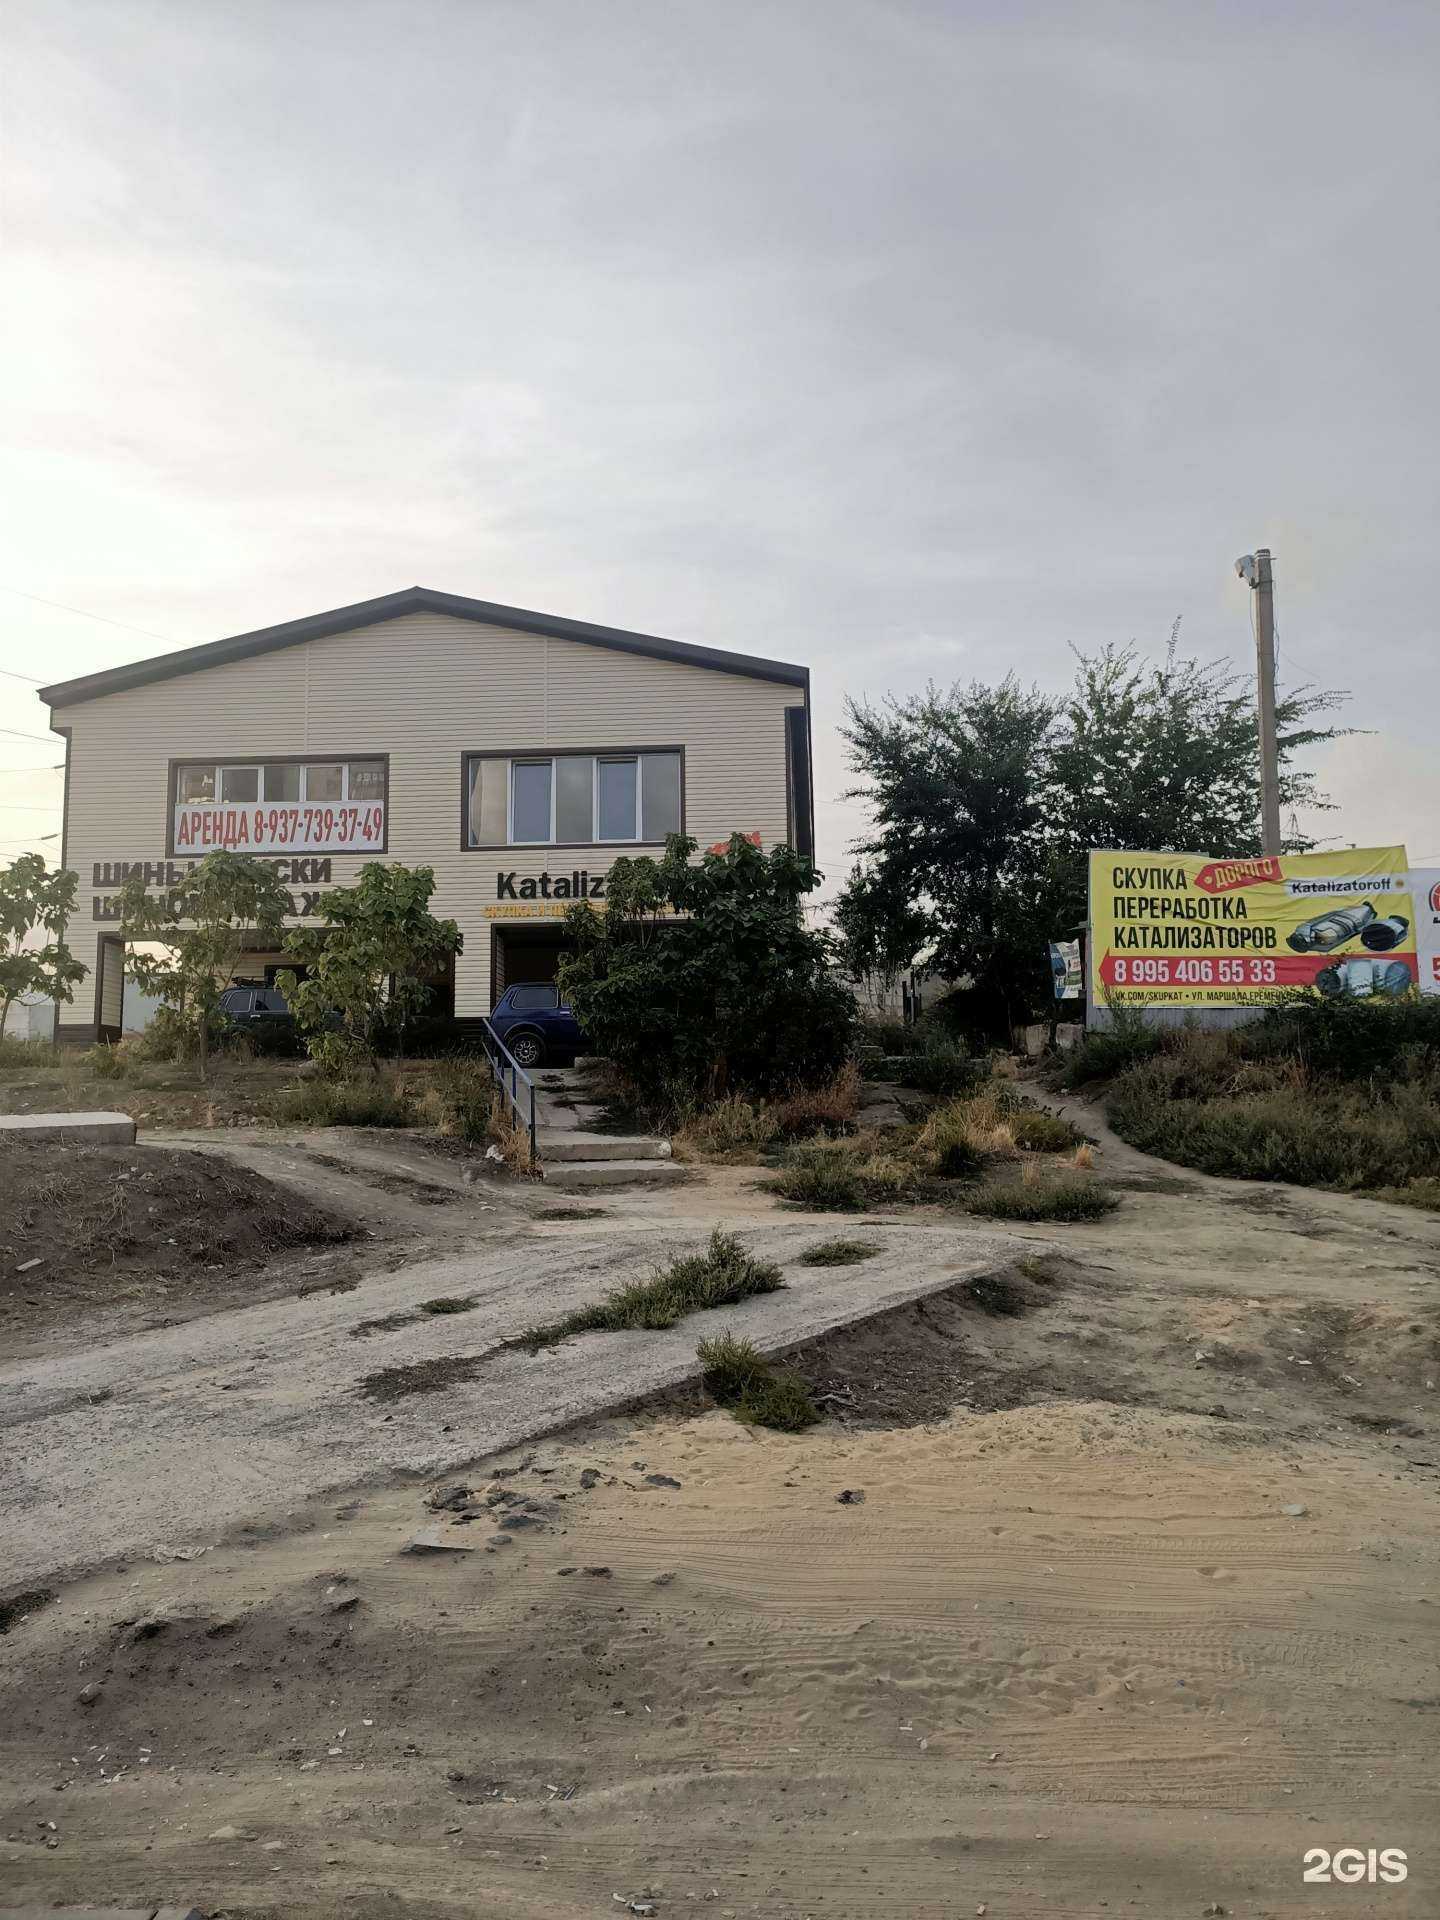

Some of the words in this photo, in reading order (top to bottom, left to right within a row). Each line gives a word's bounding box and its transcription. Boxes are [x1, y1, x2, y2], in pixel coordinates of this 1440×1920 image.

[178, 810, 249, 849] АРЕНДА
[497, 870, 605, 899] Kataliz
[1112, 867, 1188, 890] СКУПКА
[1215, 859, 1273, 888] ДОРОГО
[1292, 878, 1391, 894] Katalizatoroff
[1113, 896, 1248, 919] ПЕРЕРАБОТКА
[1114, 926, 1277, 949] КАТАЛИЗАТОРОВ
[1114, 959, 1127, 982] 8
[1132, 959, 1170, 982] 995
[1175, 959, 1213, 982] 406
[1219, 959, 1244, 982] 55
[1250, 959, 1276, 982] 33
[1115, 991, 1183, 1001] VK.COM/SKUPKAT
[1207, 990, 1248, 1001] МАРШАЛА
